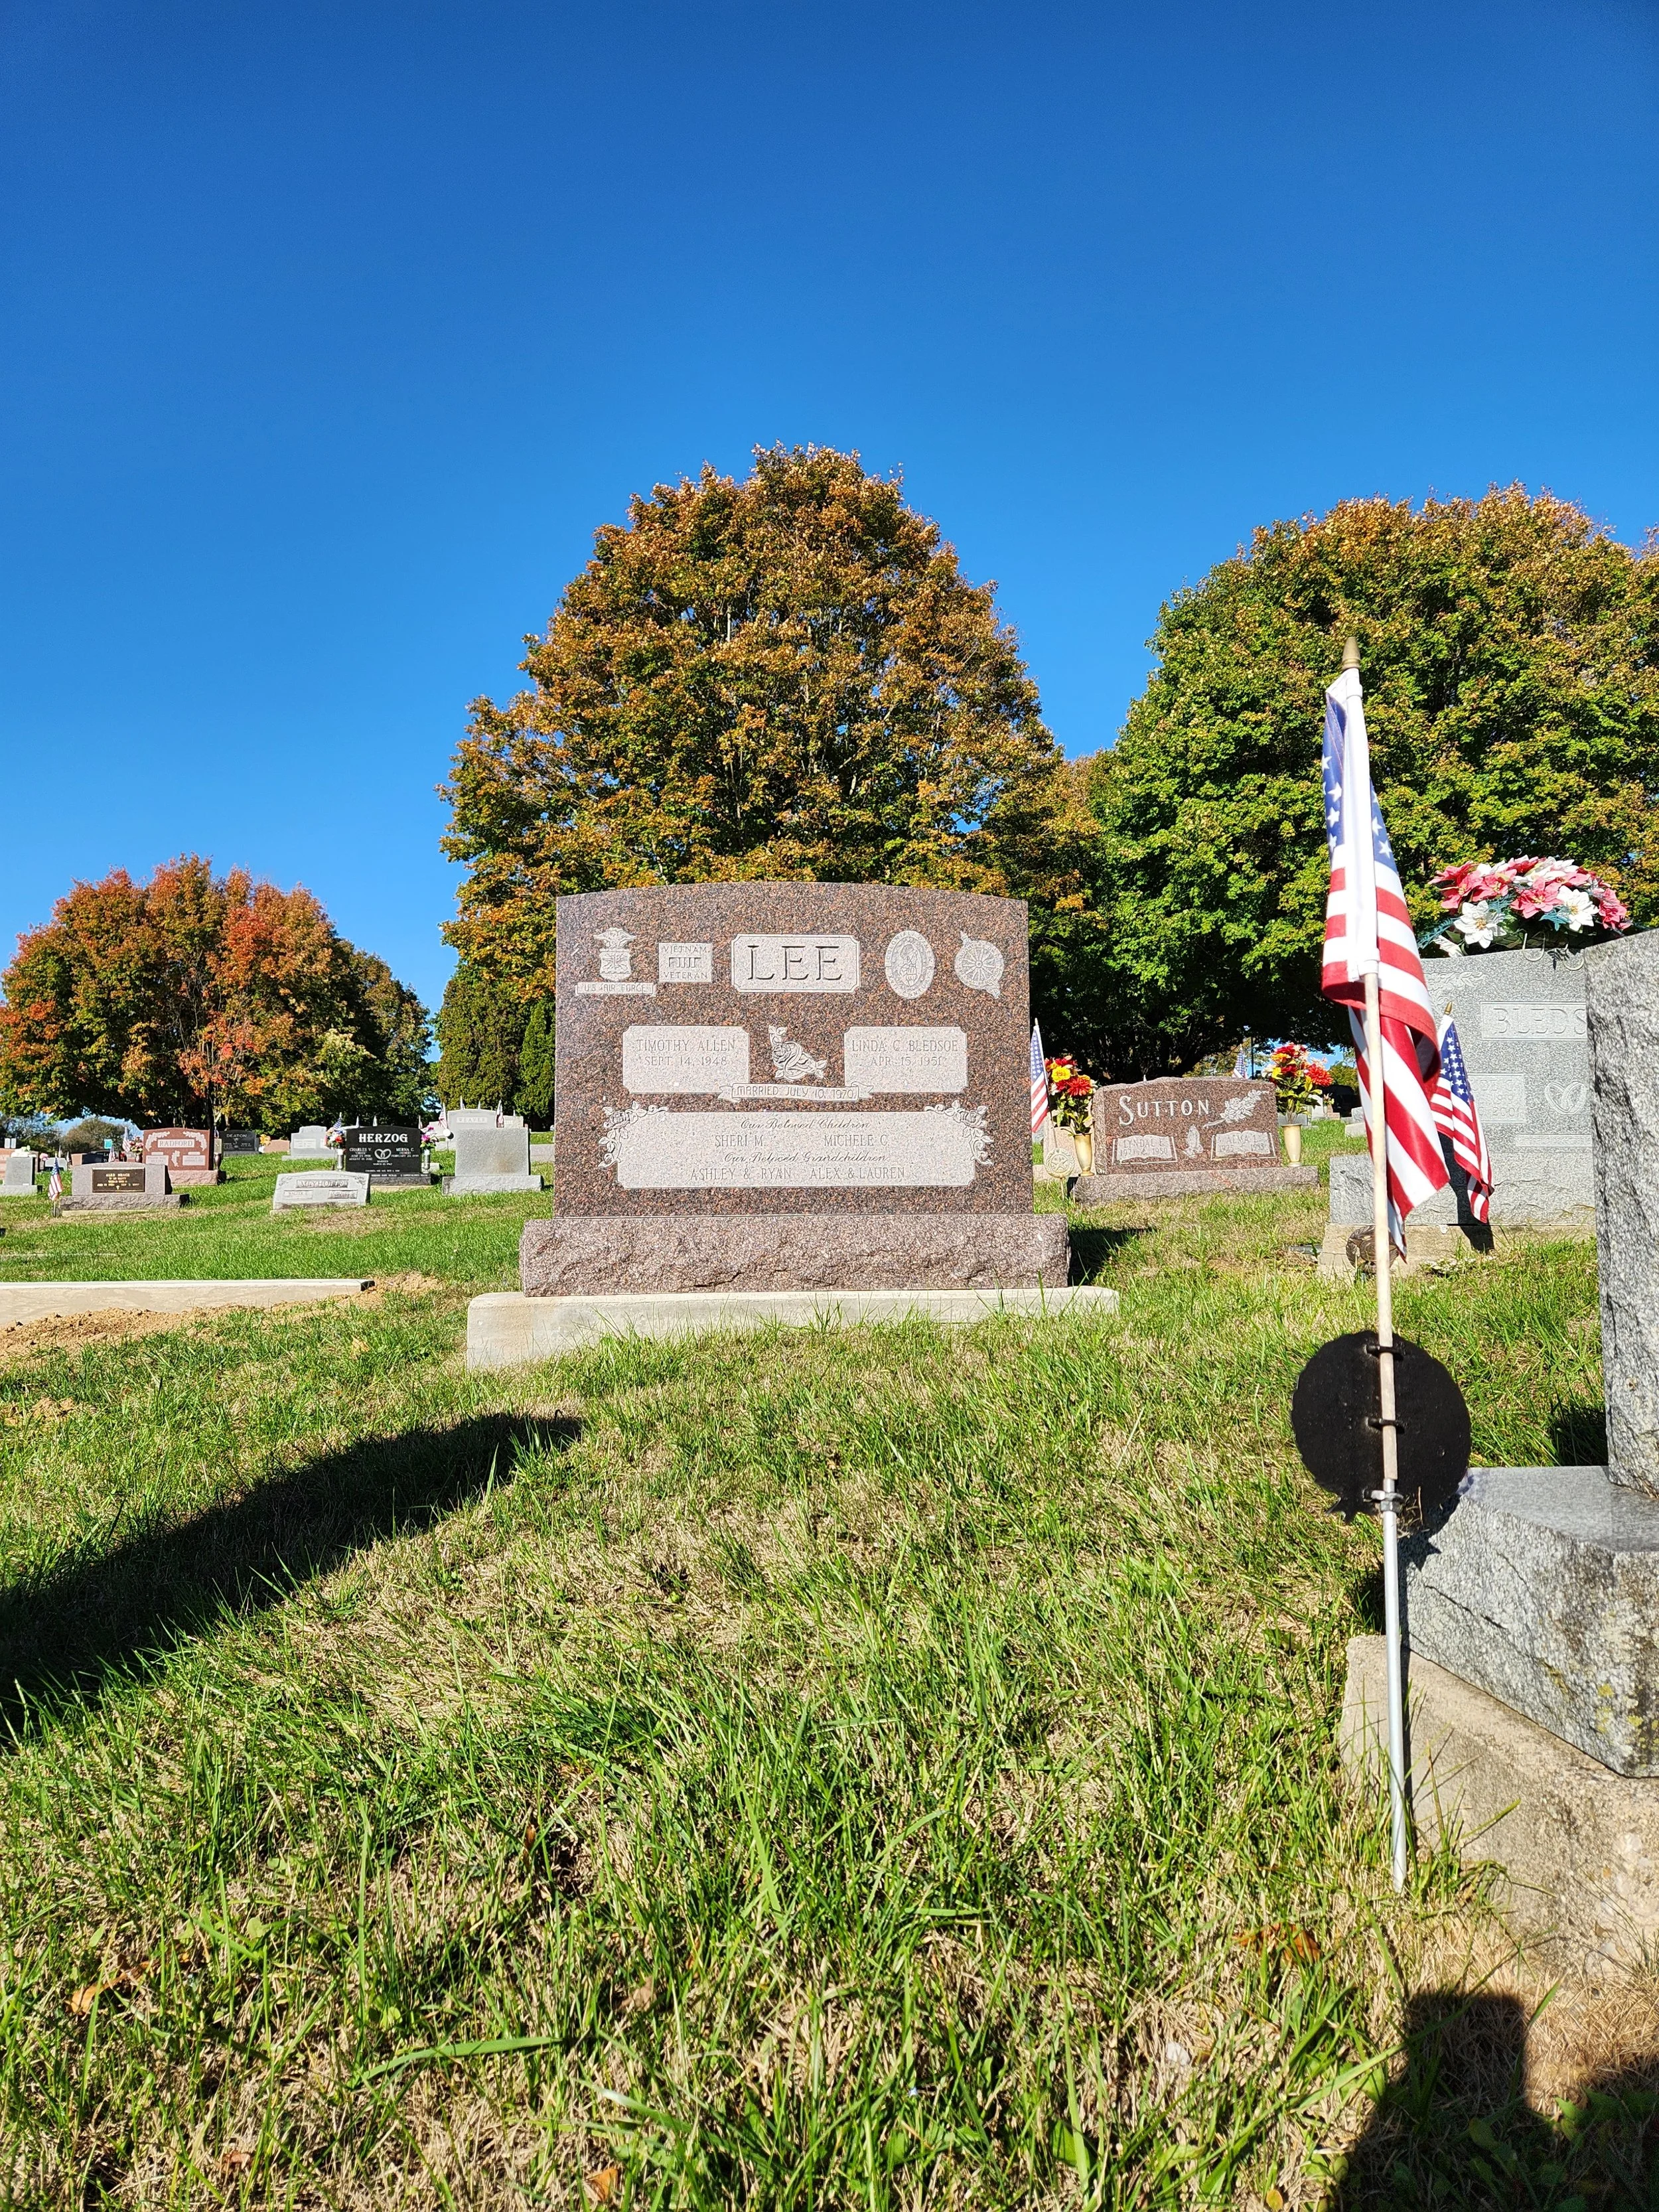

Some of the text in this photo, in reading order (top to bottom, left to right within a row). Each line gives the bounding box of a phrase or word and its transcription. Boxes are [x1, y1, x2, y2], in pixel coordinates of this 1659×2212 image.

[747, 945, 843, 981] LEE
[636, 1039, 735, 1051] TIMOTHY ALLEN
[852, 1040, 887, 1052] LINDA
[908, 1040, 958, 1052] BLEDSOE
[701, 1056, 727, 1066] 1948
[737, 1086, 779, 1096] MARRIED
[785, 1086, 809, 1097] JULY
[831, 1089, 855, 1099] 1970
[1119, 1095, 1210, 1126] SUTTON
[741, 1118, 871, 1129] Our Beloved Children
[358, 1133, 409, 1143] HERZOG
[715, 1135, 748, 1147] SHERI
[824, 1134, 874, 1147] MICHELE
[724, 1151, 891, 1163] Our Beloved Grandchildren
[690, 1167, 792, 1181] ASHLEY & RYAN
[810, 1167, 905, 1179] ALEX & LAUREN
